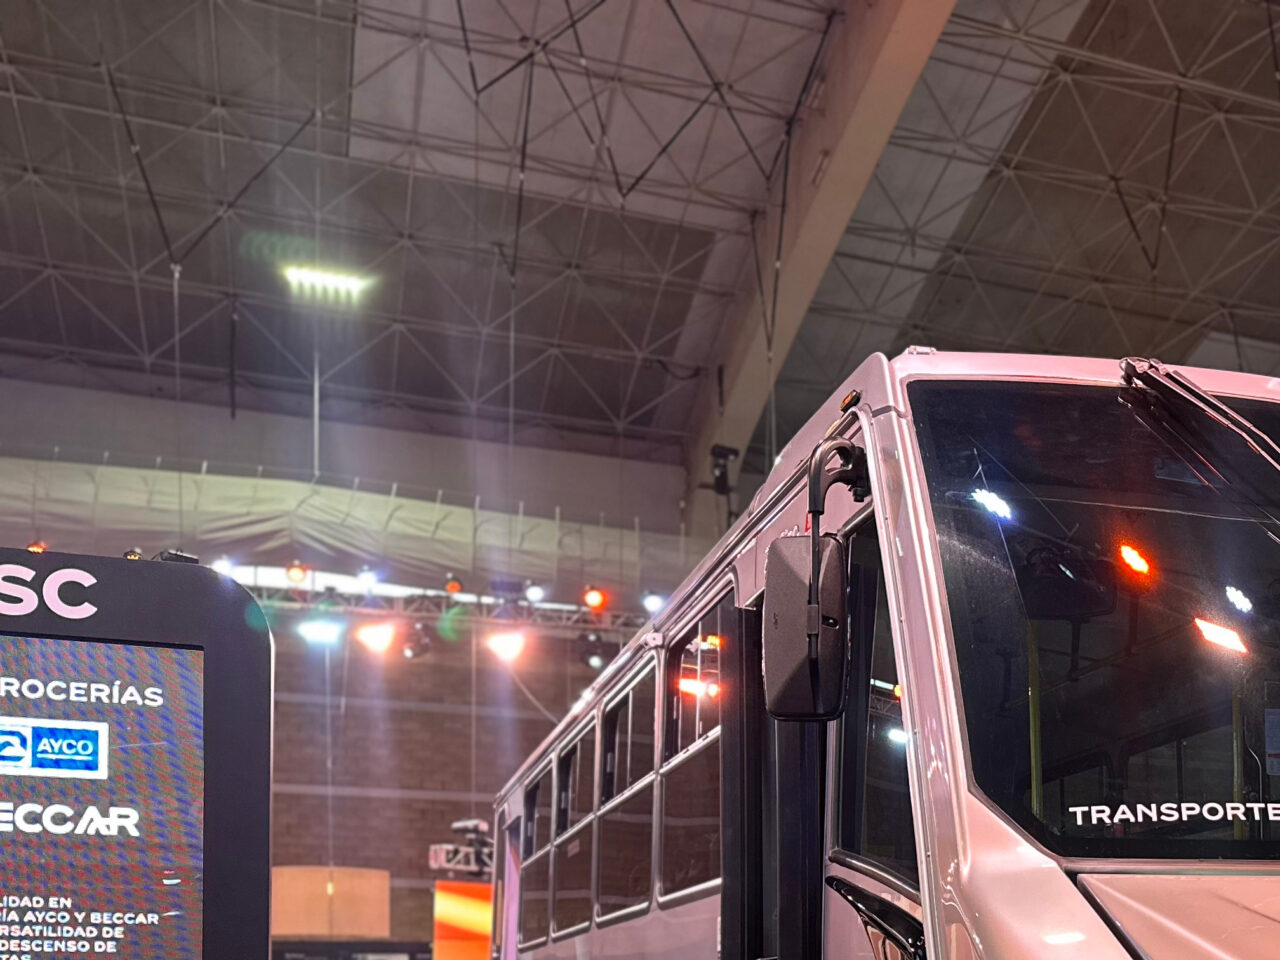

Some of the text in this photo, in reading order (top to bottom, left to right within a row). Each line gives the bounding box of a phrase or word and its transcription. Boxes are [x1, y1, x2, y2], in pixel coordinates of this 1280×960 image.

[0, 677, 164, 707] ROCERÍAS
[36, 738, 94, 755] AYCO
[0, 896, 72, 908] IDAD EN
[0, 908, 159, 925] ÍA AYCO Y BECCAR
[0, 925, 125, 938] RSATILIDAD DE
[0, 939, 117, 953] DESCENSO DE
